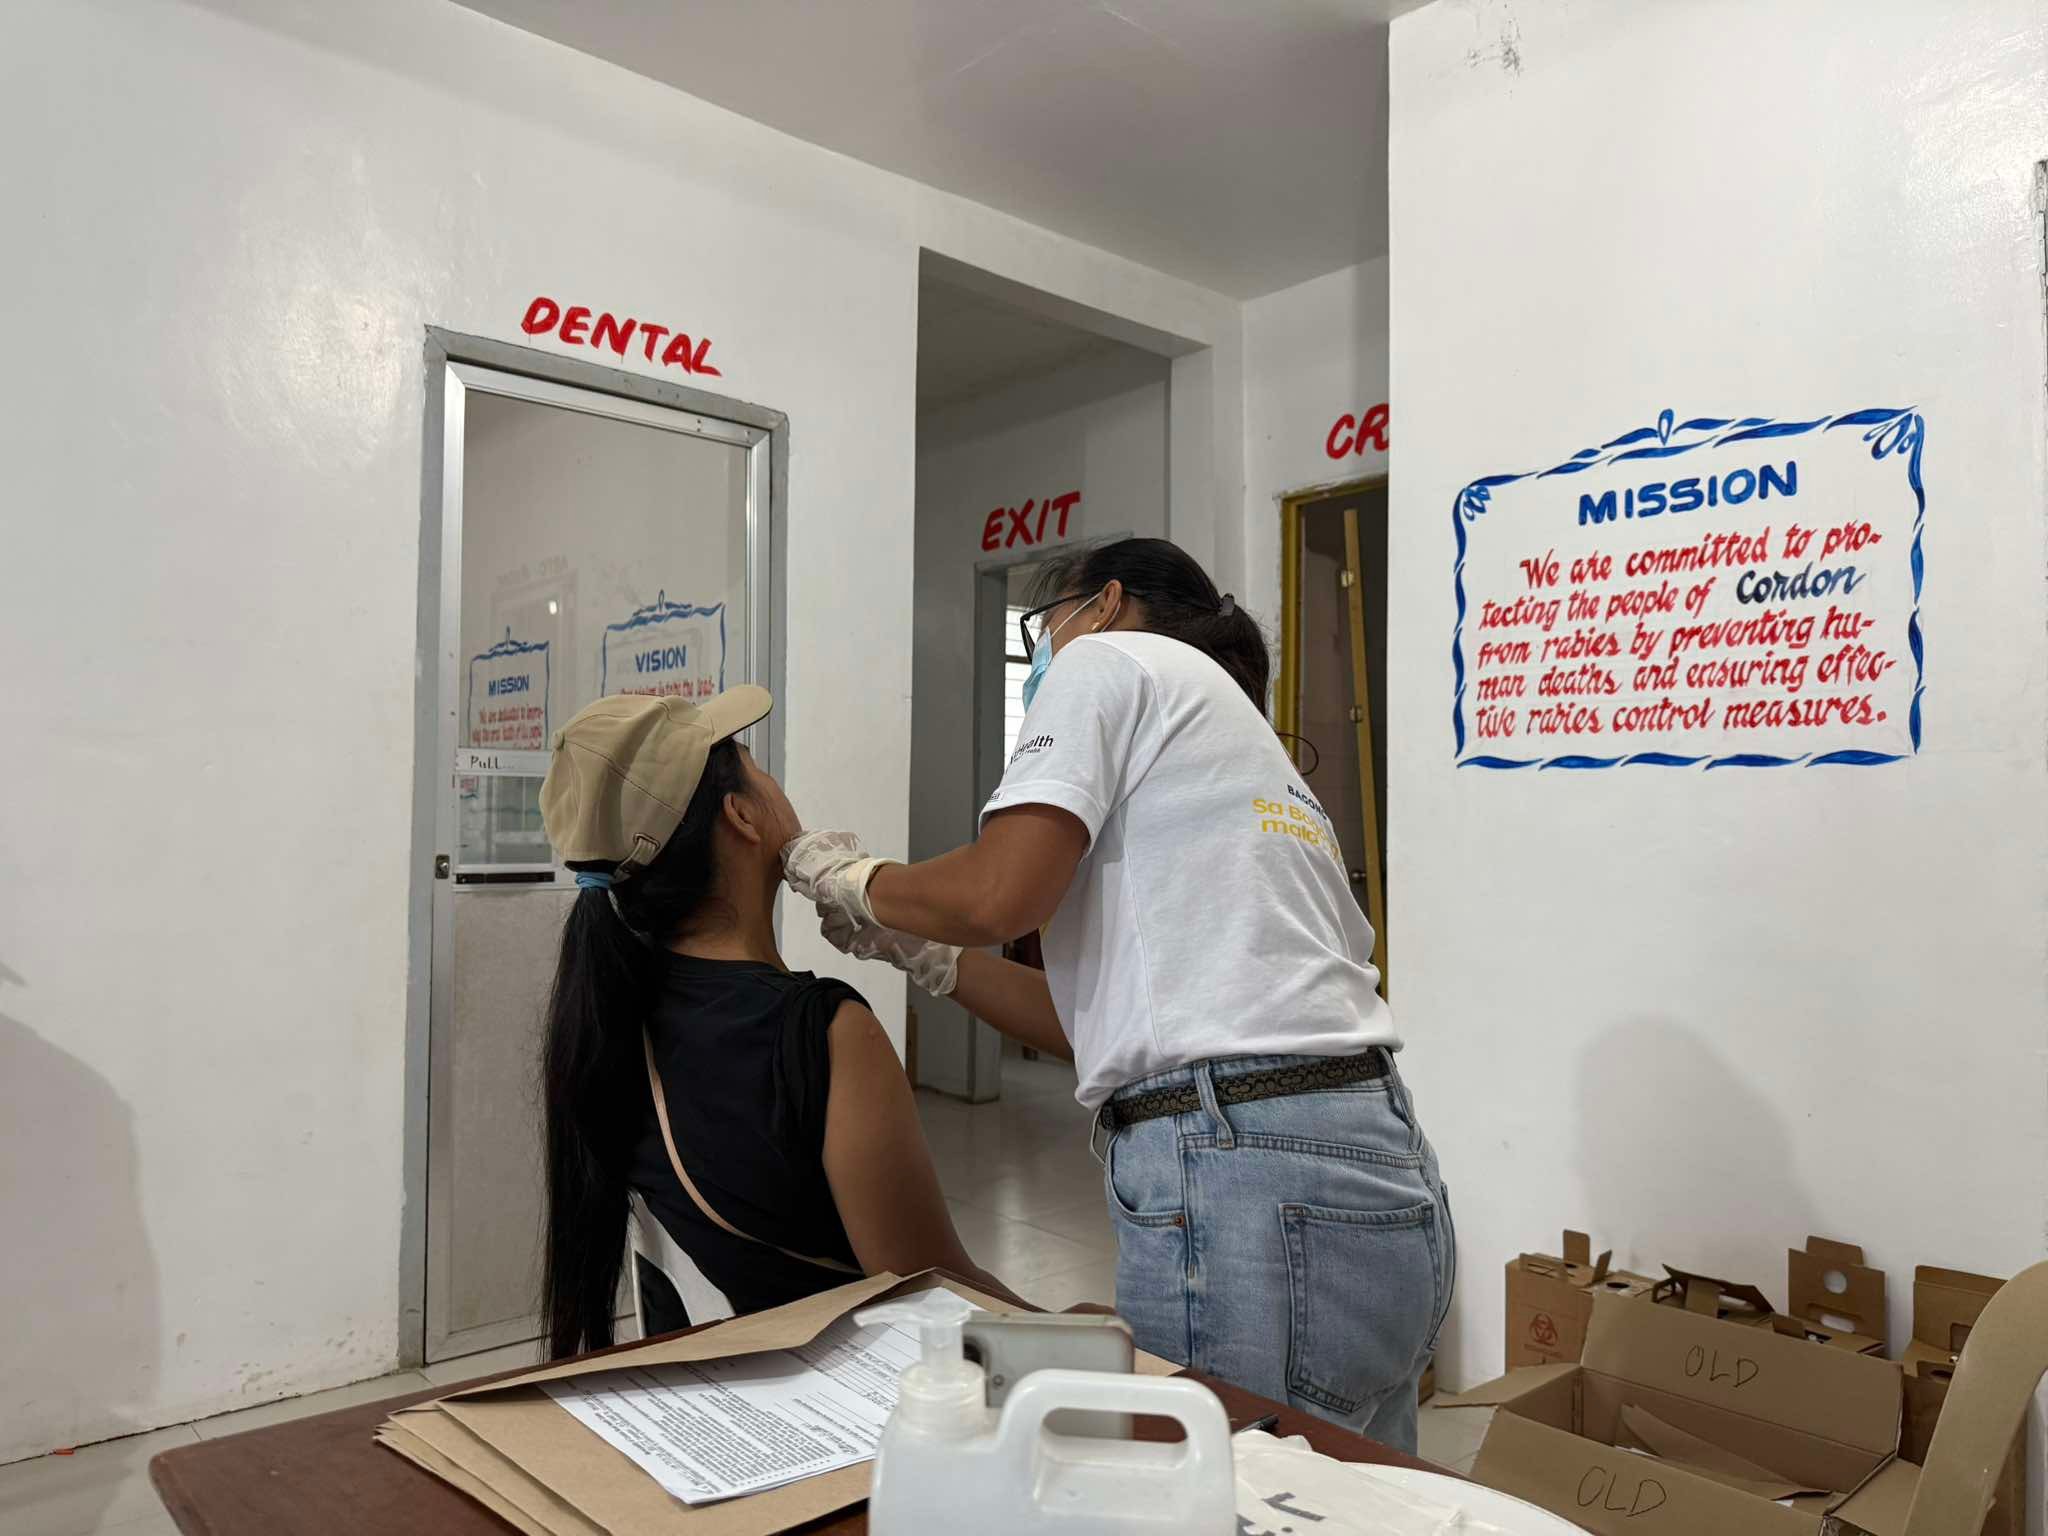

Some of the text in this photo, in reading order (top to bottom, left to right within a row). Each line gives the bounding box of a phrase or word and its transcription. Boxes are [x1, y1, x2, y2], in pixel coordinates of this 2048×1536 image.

[521, 297, 722, 377] DENTAL
[1326, 403, 1389, 460] CR
[982, 491, 1081, 552] EXIT
[1578, 460, 1797, 526] MISSION
[1519, 519, 1882, 589] We are committed to pro-
[1479, 561, 1867, 632] tecting the people of Cordon
[635, 645, 686, 673] VISION
[1478, 605, 1876, 670] from rabies by preventing hu-
[488, 676, 530, 697] MISSION
[1477, 643, 1897, 701] man deaths and ensuring effec-
[1476, 694, 1887, 738] tive rabies control measures.
[1251, 799, 1284, 817] Sa
[1684, 1344, 1760, 1388] OLD
[1577, 1466, 1667, 1517] OLD
